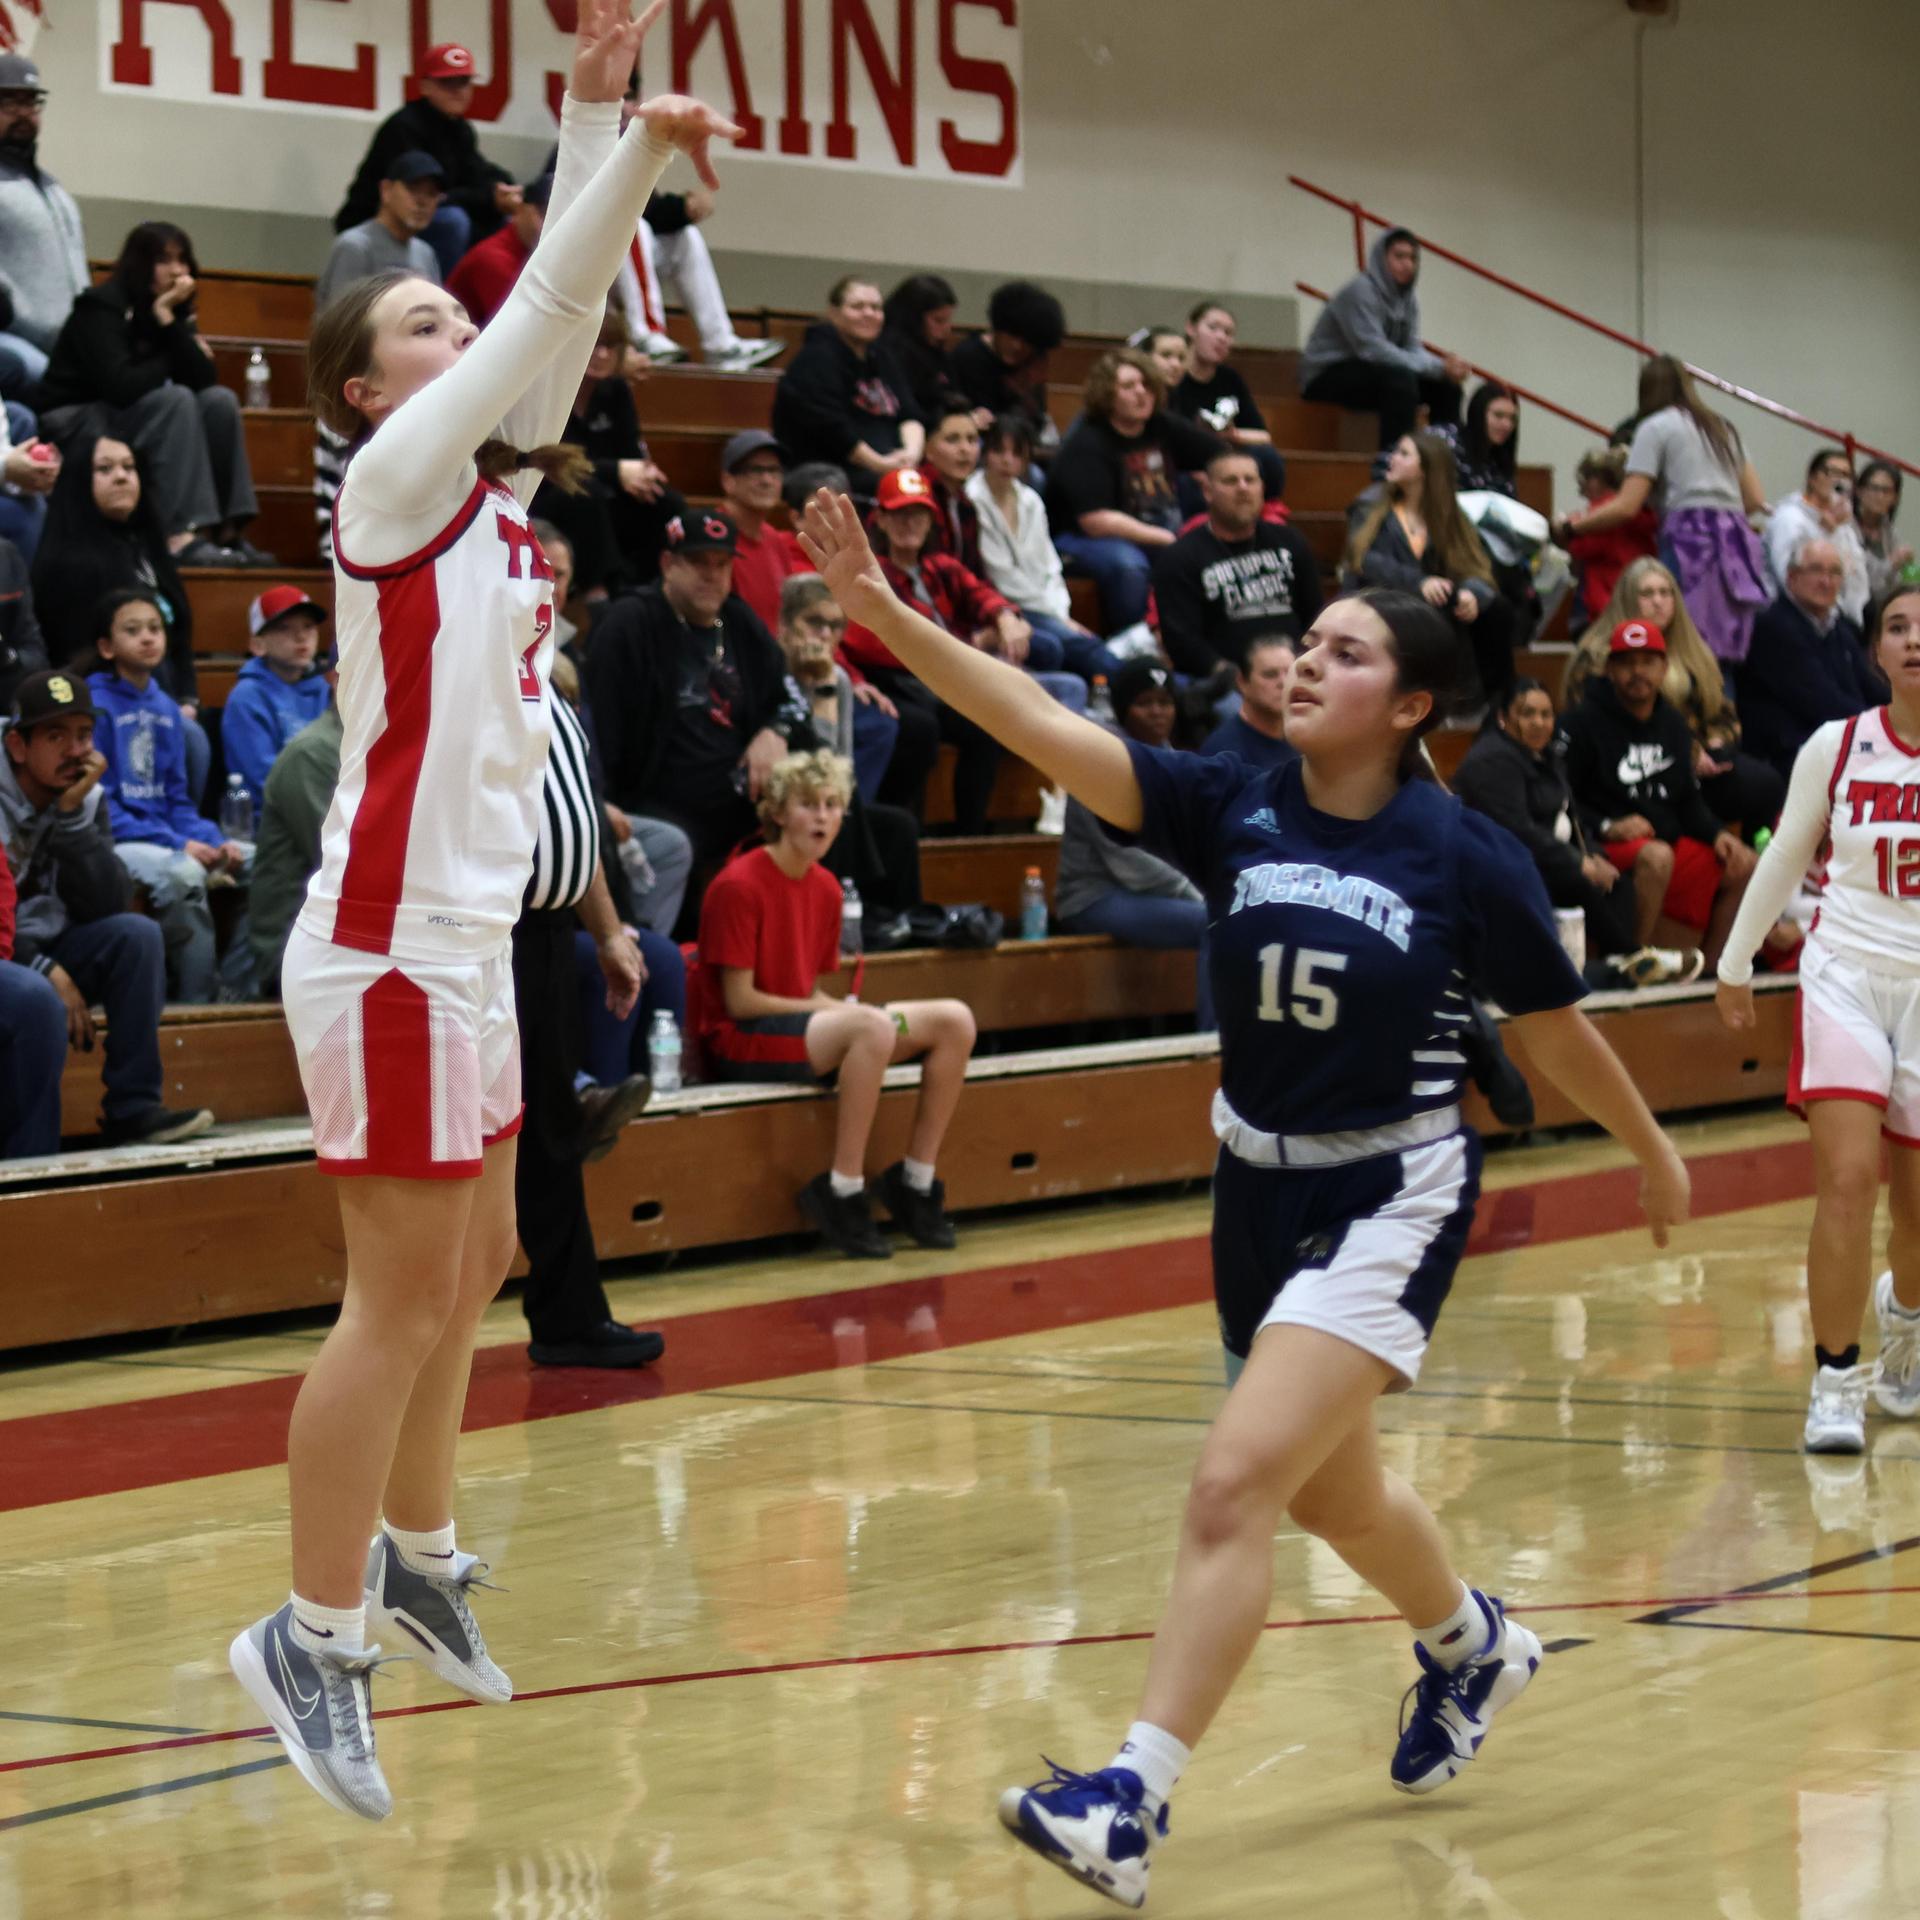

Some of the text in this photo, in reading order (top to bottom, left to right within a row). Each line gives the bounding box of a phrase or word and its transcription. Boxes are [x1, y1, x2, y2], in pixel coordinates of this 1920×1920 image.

[1846, 779, 1920, 827] TRI
[1872, 836, 1920, 900] 12
[1229, 862, 1414, 953] YOSEMITE
[1257, 942, 1348, 1031] 15
